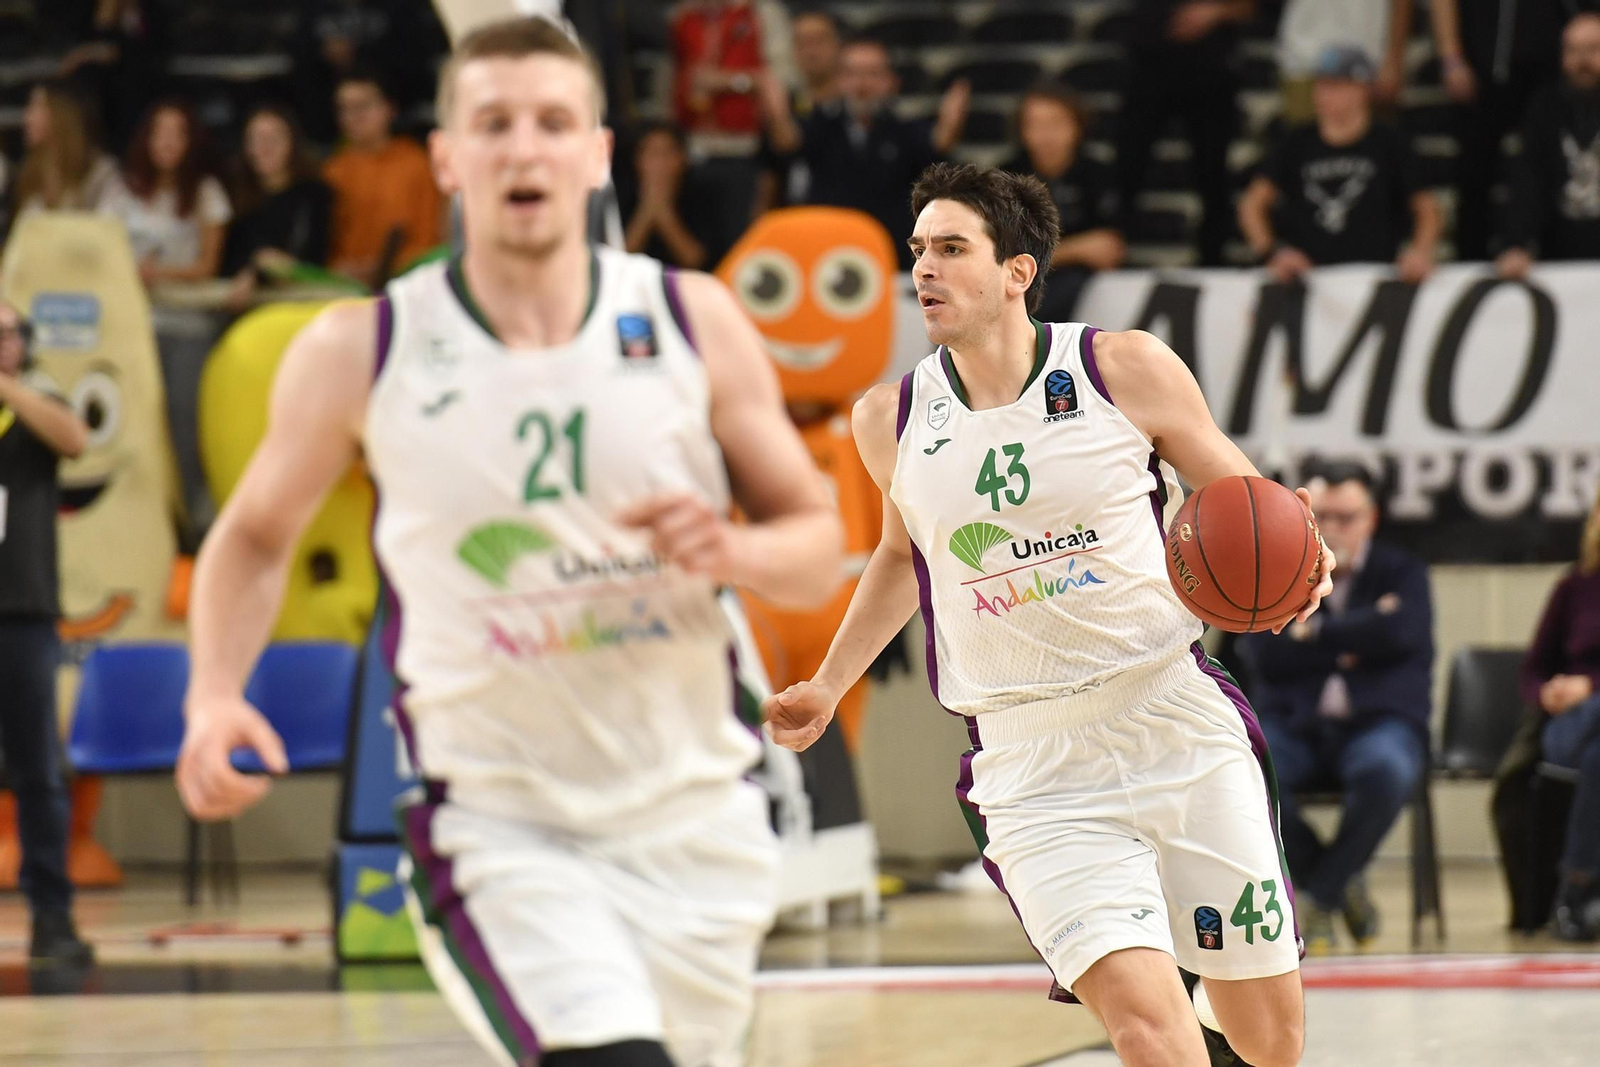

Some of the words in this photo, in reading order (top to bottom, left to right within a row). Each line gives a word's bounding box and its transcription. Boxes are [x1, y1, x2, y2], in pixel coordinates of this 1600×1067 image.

[515, 405, 588, 506] 21
[975, 442, 1031, 512] 43
[1010, 523, 1099, 560] Unicaja
[972, 557, 1107, 620] Andalucía
[1230, 879, 1284, 945] 43
